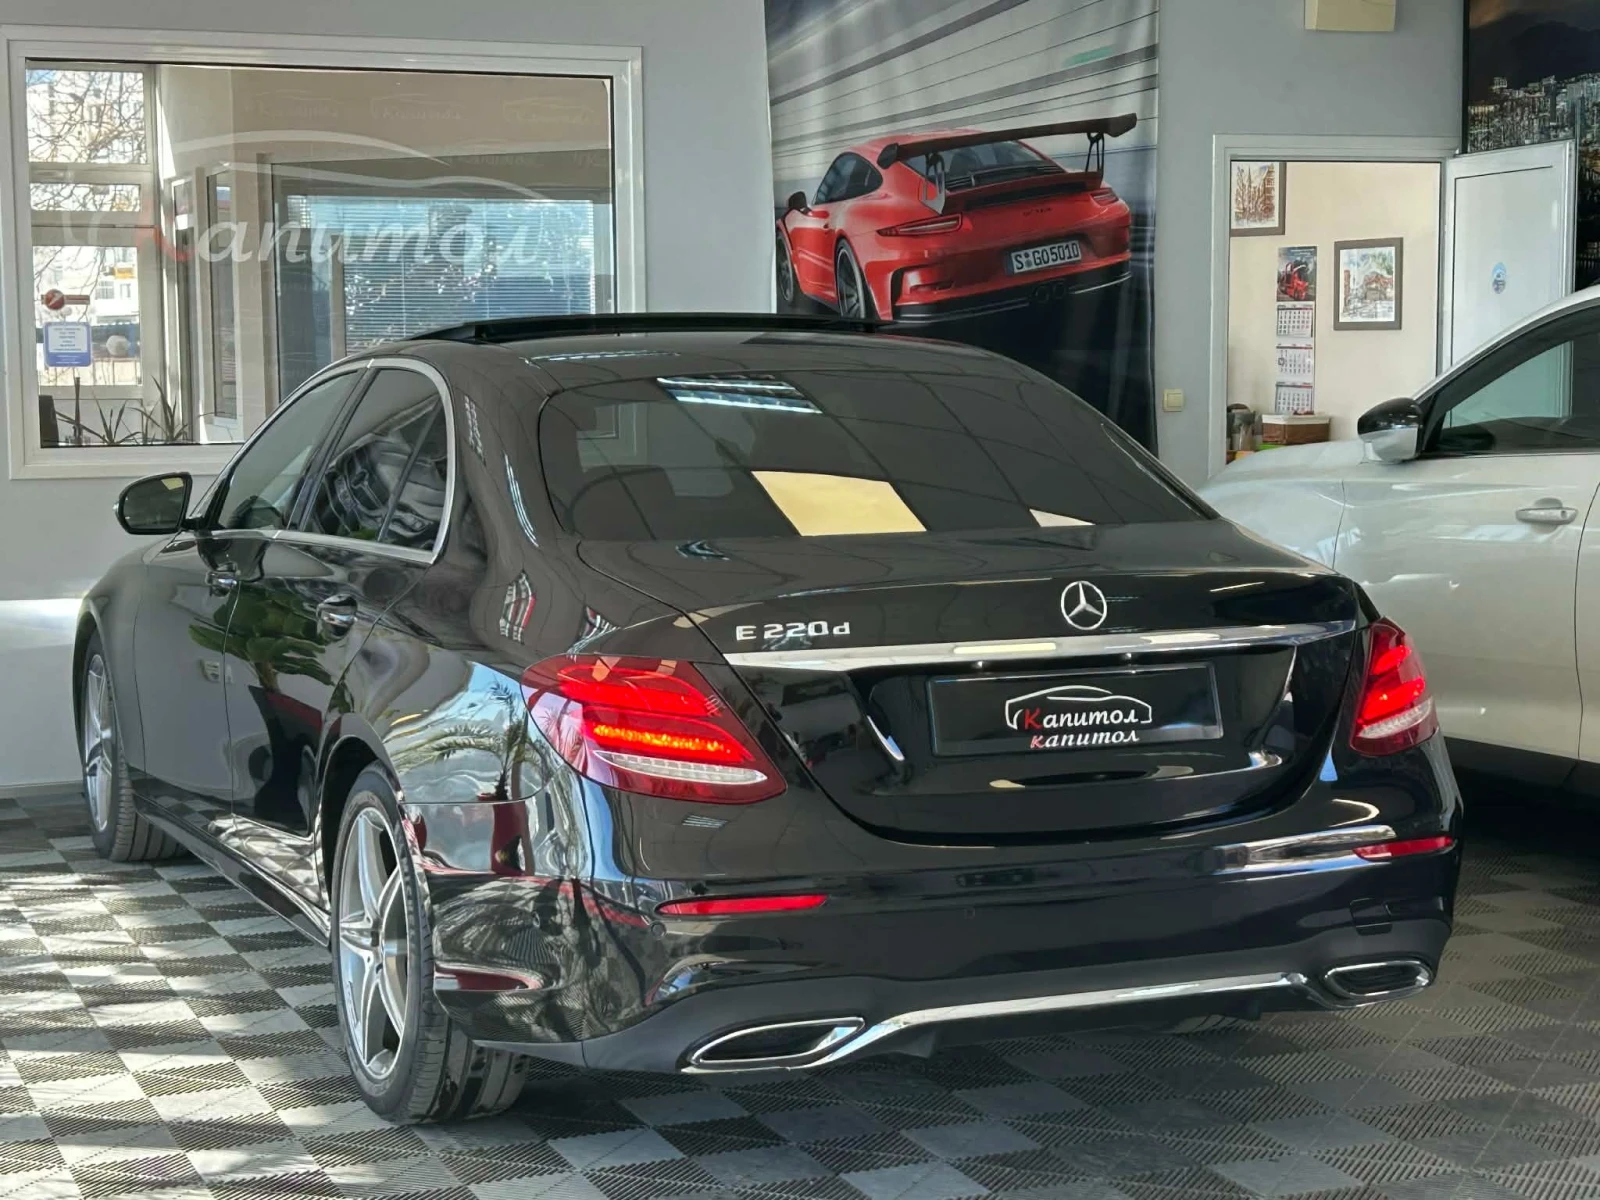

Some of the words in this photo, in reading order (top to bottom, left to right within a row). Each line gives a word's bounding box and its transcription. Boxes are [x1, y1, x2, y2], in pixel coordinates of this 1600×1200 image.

[735, 625, 757, 641] E
[1024, 707, 1138, 730] Капитол
[1030, 729, 1140, 749] капитол
